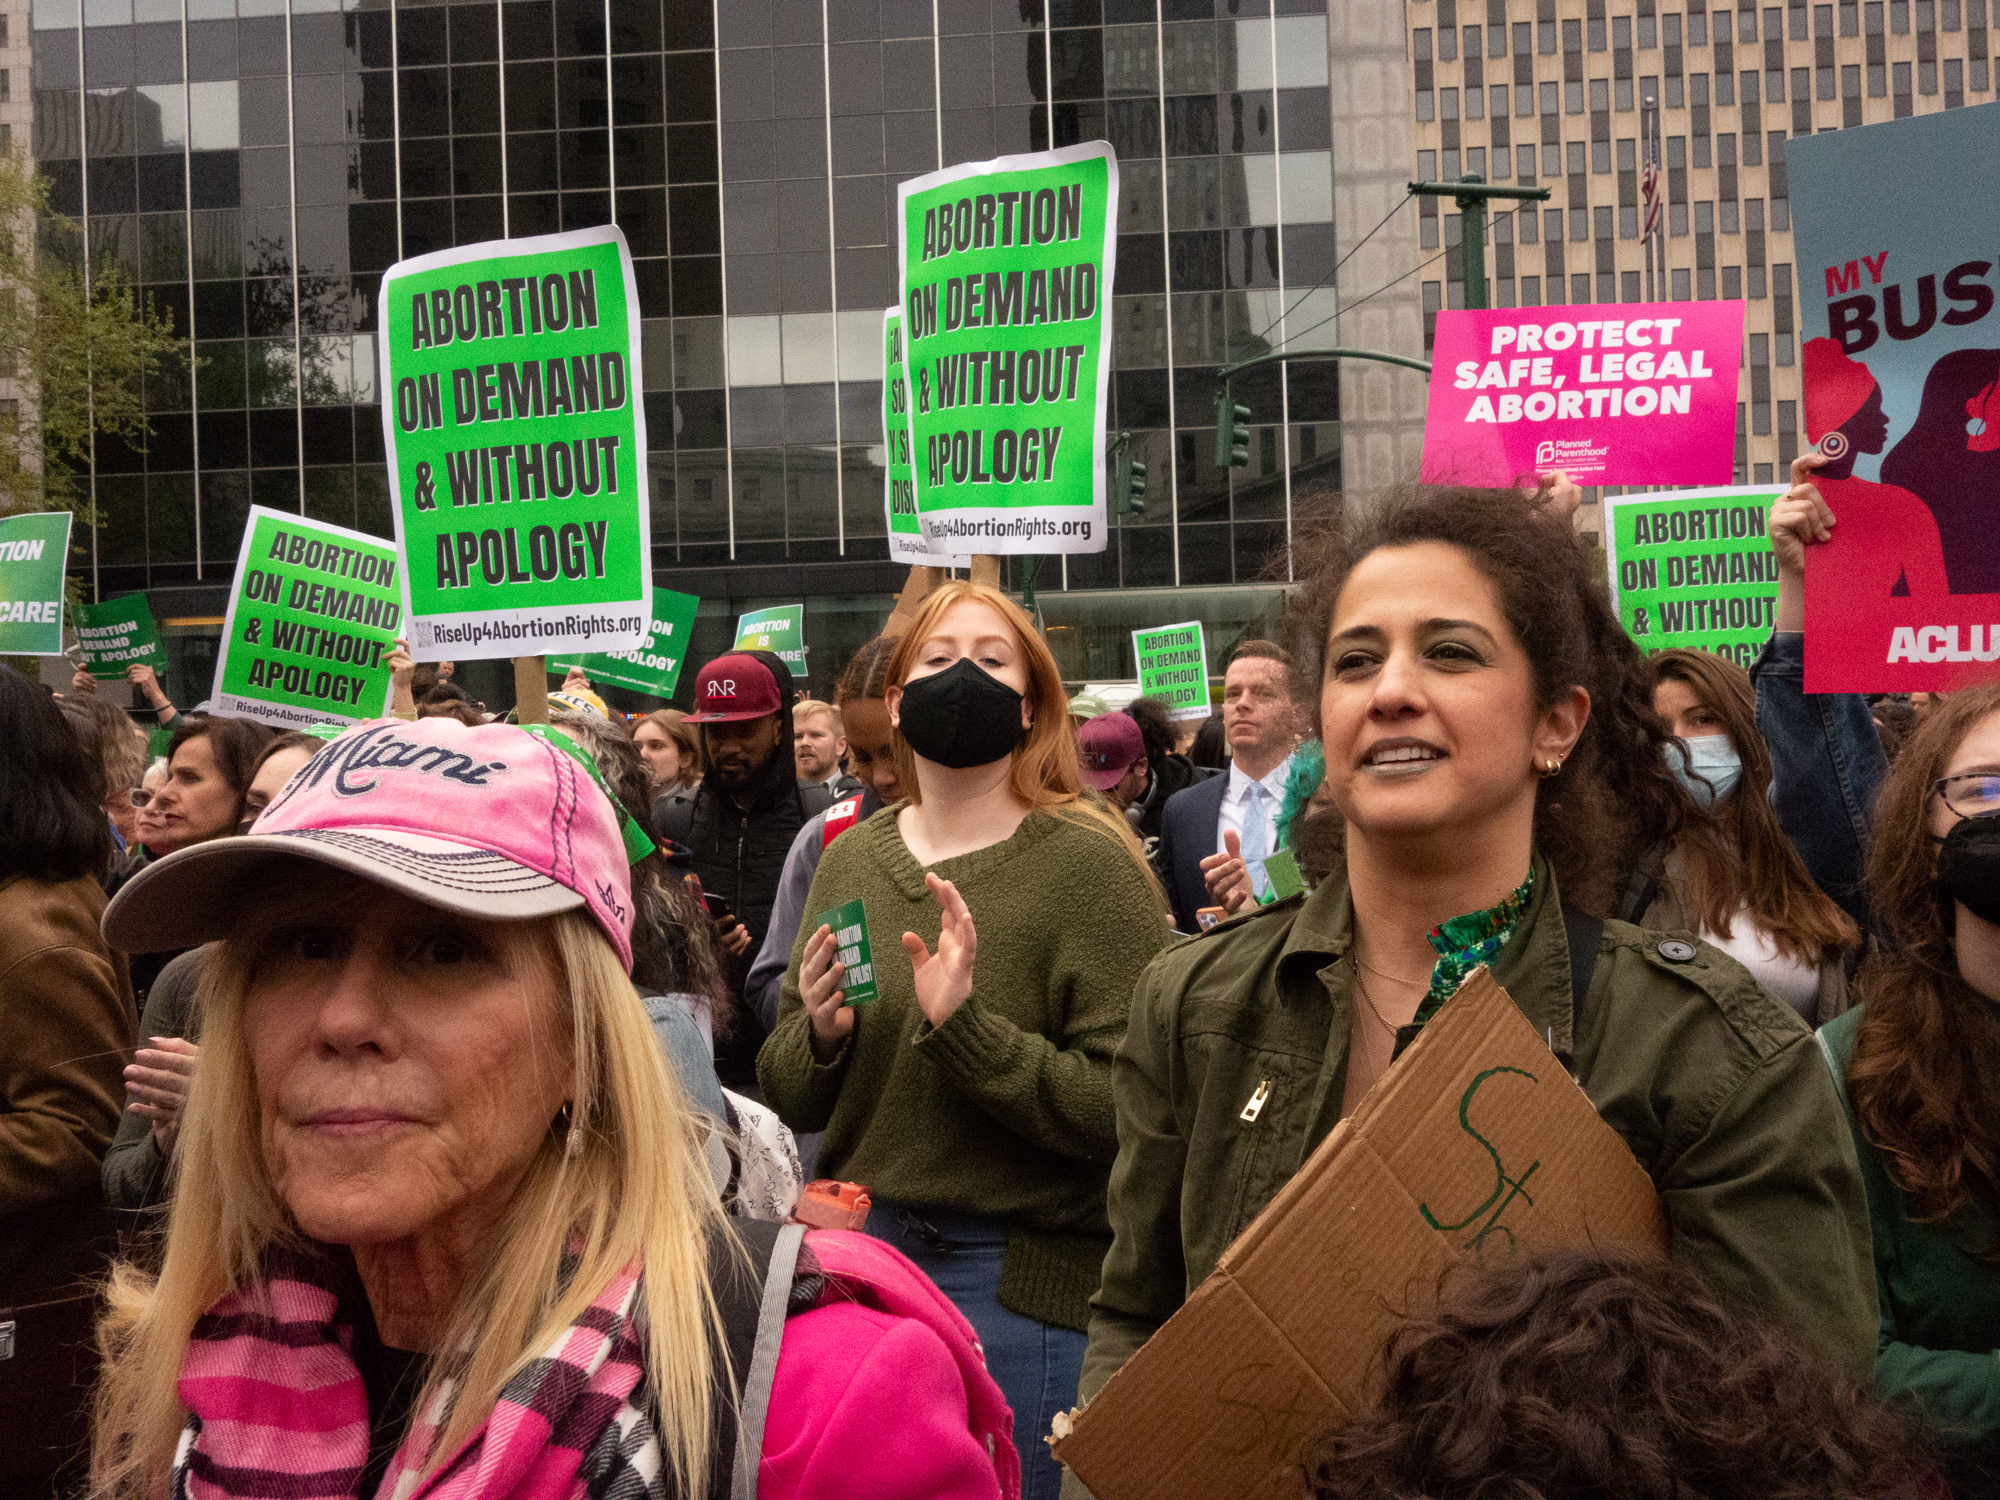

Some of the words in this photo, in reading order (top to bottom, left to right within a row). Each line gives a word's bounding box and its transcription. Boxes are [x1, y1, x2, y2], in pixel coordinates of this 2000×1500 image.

[922, 184, 1082, 262] ABORTION
[1825, 250, 1888, 297] MY
[411, 269, 598, 351] ABORTION
[910, 284, 939, 340] ON
[946, 262, 1097, 332] DEMAND
[1828, 254, 2000, 356] BUS
[1491, 318, 1681, 354] PROTECT
[918, 366, 931, 415] &
[936, 345, 1085, 409] WITHOUT
[1453, 357, 1566, 389] SAFE,
[1579, 350, 1712, 383] LEGAL
[398, 372, 442, 433] ON
[453, 351, 626, 426] DEMAND
[1464, 385, 1691, 423] ABORTION
[928, 426, 1063, 488] APOLOGY
[1555, 446, 1607, 458] Parenthood
[1556, 438, 1592, 448] Planned
[414, 461, 437, 511] &
[445, 436, 620, 507] WITHOUT
[929, 517, 1091, 541] RiseUp4AbortionRights.org
[1635, 506, 1766, 546] ABORTION
[268, 531, 396, 589] ABORTION
[436, 520, 608, 590] APOLOGY
[1621, 558, 1658, 592] ON
[1667, 551, 1779, 588] DEMAND
[245, 570, 283, 605] ON
[288, 579, 399, 631] DEMAND
[1632, 607, 1650, 636] &
[1658, 596, 1777, 634] WITHOUT
[80, 620, 138, 638] ABORTION
[83, 636, 130, 650] DEMAND
[243, 617, 262, 645] &
[272, 619, 386, 670] WITHOUT
[433, 615, 641, 645] RiseUp4AbortionRights.org
[742, 619, 790, 636] ABORTION
[758, 635, 769, 647] IS
[1144, 631, 1193, 650] ABORTION
[1886, 624, 2000, 663] ACLU
[101, 642, 156, 662] APOLOGY
[778, 650, 802, 662] ARE
[1141, 657, 1154, 670] ON
[1157, 649, 1201, 667] DEMAND
[247, 658, 366, 706] APOLOGY
[1146, 677, 1153, 688] &
[1155, 668, 1199, 687] WITHOUT
[263, 722, 508, 818] Miami
